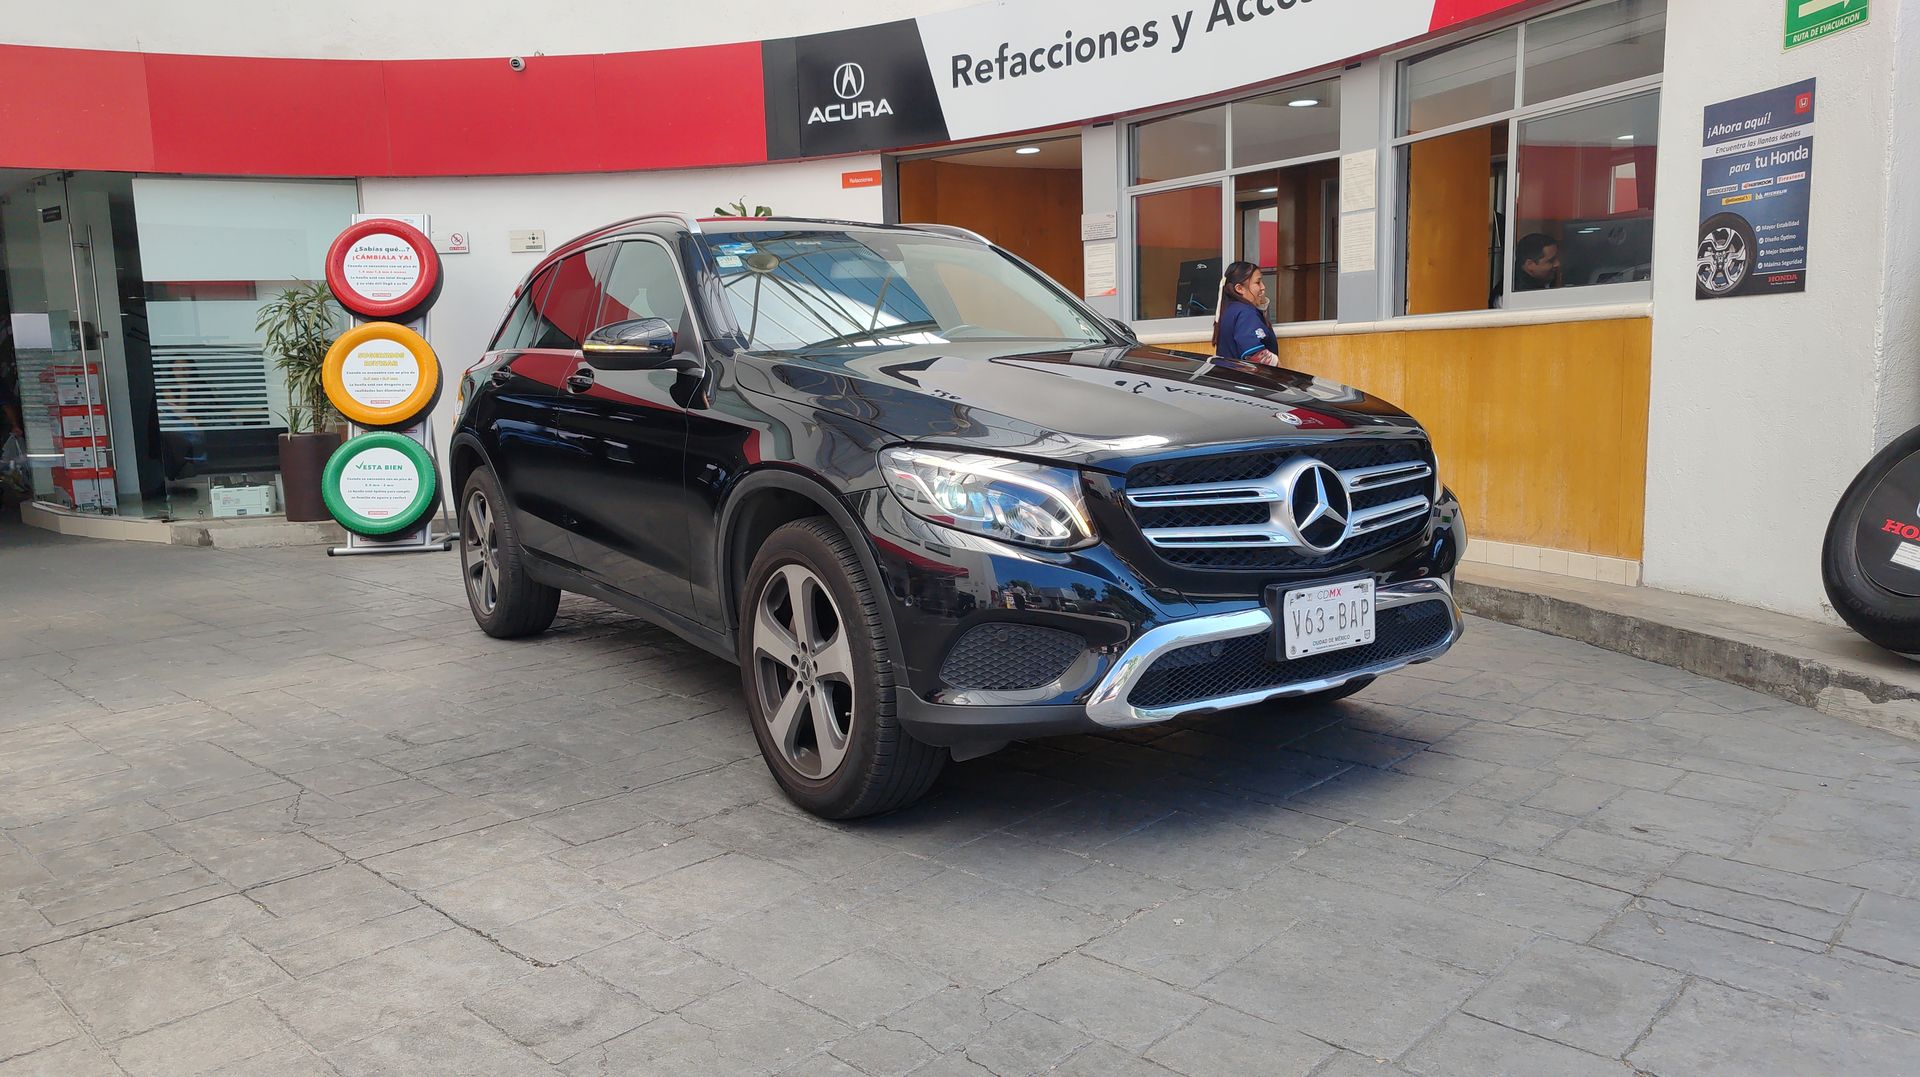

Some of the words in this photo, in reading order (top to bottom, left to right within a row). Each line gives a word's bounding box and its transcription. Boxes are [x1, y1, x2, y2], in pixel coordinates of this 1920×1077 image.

[1792, 31, 1809, 44] RUTA
[1810, 28, 1819, 37] DE
[1819, 11, 1861, 34] EVACUACION
[951, 20, 1159, 89] Refacciones
[1171, 10, 1193, 54] y
[807, 98, 894, 125] ACURA
[1707, 122, 1742, 139] ¡Ahora
[1744, 111, 1772, 130] aquí!
[1715, 142, 1746, 154] Encuentra
[1747, 139, 1756, 147] las
[1757, 135, 1778, 145] llantas
[1779, 129, 1801, 140] ideales
[1728, 162, 1751, 176] para
[1754, 155, 1768, 169] tu
[1770, 145, 1808, 166] Honda
[1776, 220, 1800, 229] Estabilidad
[1781, 258, 1803, 267] Seguridad
[1768, 273, 1798, 282] HONDA
[1882, 518, 1920, 543] HO
[1316, 587, 1342, 600] CDMX
[1292, 599, 1369, 640] V63-BAP
[1312, 638, 1328, 647] CIUDAD
